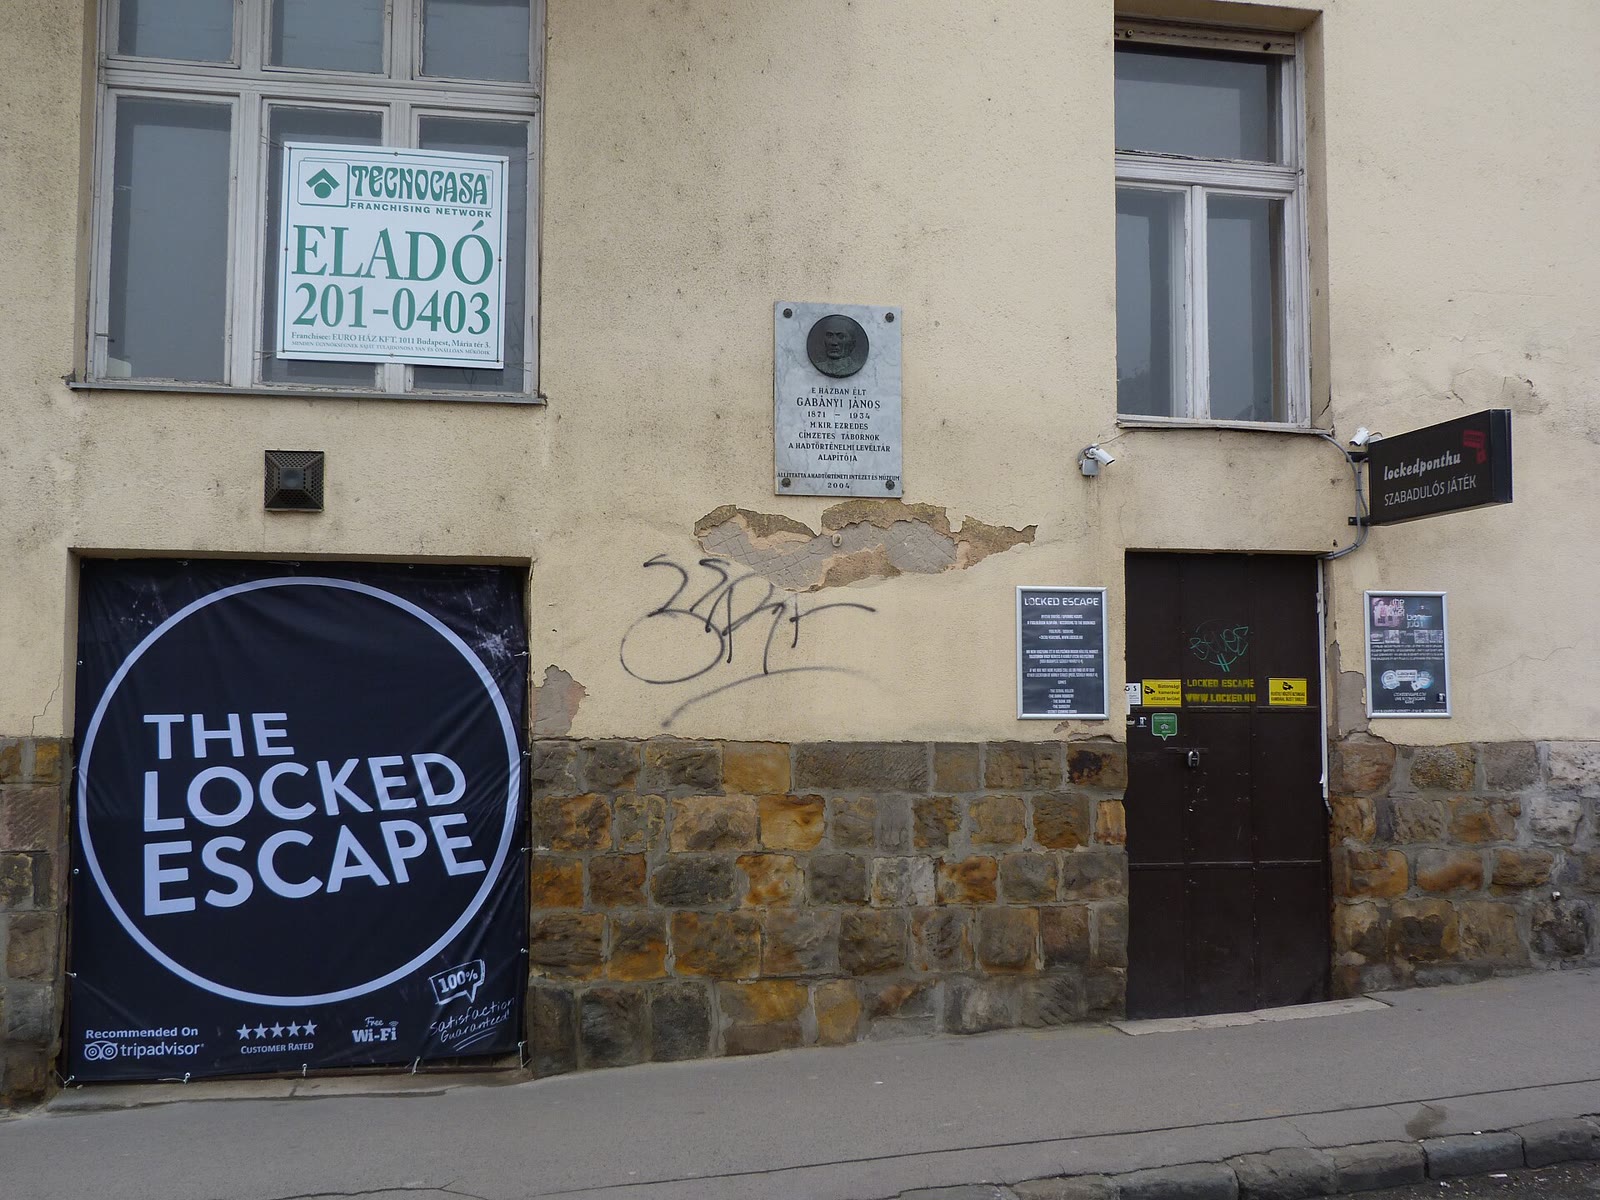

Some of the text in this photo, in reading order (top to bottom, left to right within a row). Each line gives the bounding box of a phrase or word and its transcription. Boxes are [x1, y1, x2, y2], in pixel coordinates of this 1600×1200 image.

[351, 165, 488, 205] TECNOCASA
[350, 201, 492, 218] FRANCHISING NETWORK
[291, 219, 494, 286] ELADÓ
[292, 282, 491, 335] 201-0403
[291, 331, 331, 341] Franchisee:
[332, 333, 357, 342] EURO
[358, 333, 378, 342] HÁZ
[399, 336, 415, 344] 1011
[416, 337, 451, 347] Budapest,
[451, 339, 473, 348] Mária
[473, 340, 483, 348] tér
[484, 341, 491, 349] 3.
[818, 386, 850, 395] HÁZBAN
[852, 386, 867, 396] ÉLT
[796, 395, 881, 410] GABÁNYI JÁNOS
[807, 410, 826, 418] 1871
[849, 412, 870, 420] 1934
[834, 422, 869, 431] EZREDES
[798, 429, 880, 441] CÍMZETES TÁBORNOK
[788, 442, 794, 450] A
[856, 443, 891, 453] LEVÉLTÁR
[817, 452, 858, 463] ALAPÍTÓJA
[1384, 473, 1477, 507] SZABADULÓS JÁTÉK
[1024, 597, 1099, 606] LOCKED ESCAPE
[1186, 679, 1255, 688] LOCKED ESCAPE
[143, 712, 295, 760] THE
[143, 752, 467, 832] LOCKED
[144, 813, 487, 917] ESCAPE
[438, 969, 479, 994] 100%
[364, 1016, 385, 1028] Free
[429, 997, 516, 1037] Satisfaction
[85, 1026, 199, 1039] Recommended On
[351, 1027, 398, 1043] Wi-Fi
[120, 1041, 200, 1060] tripadvisor
